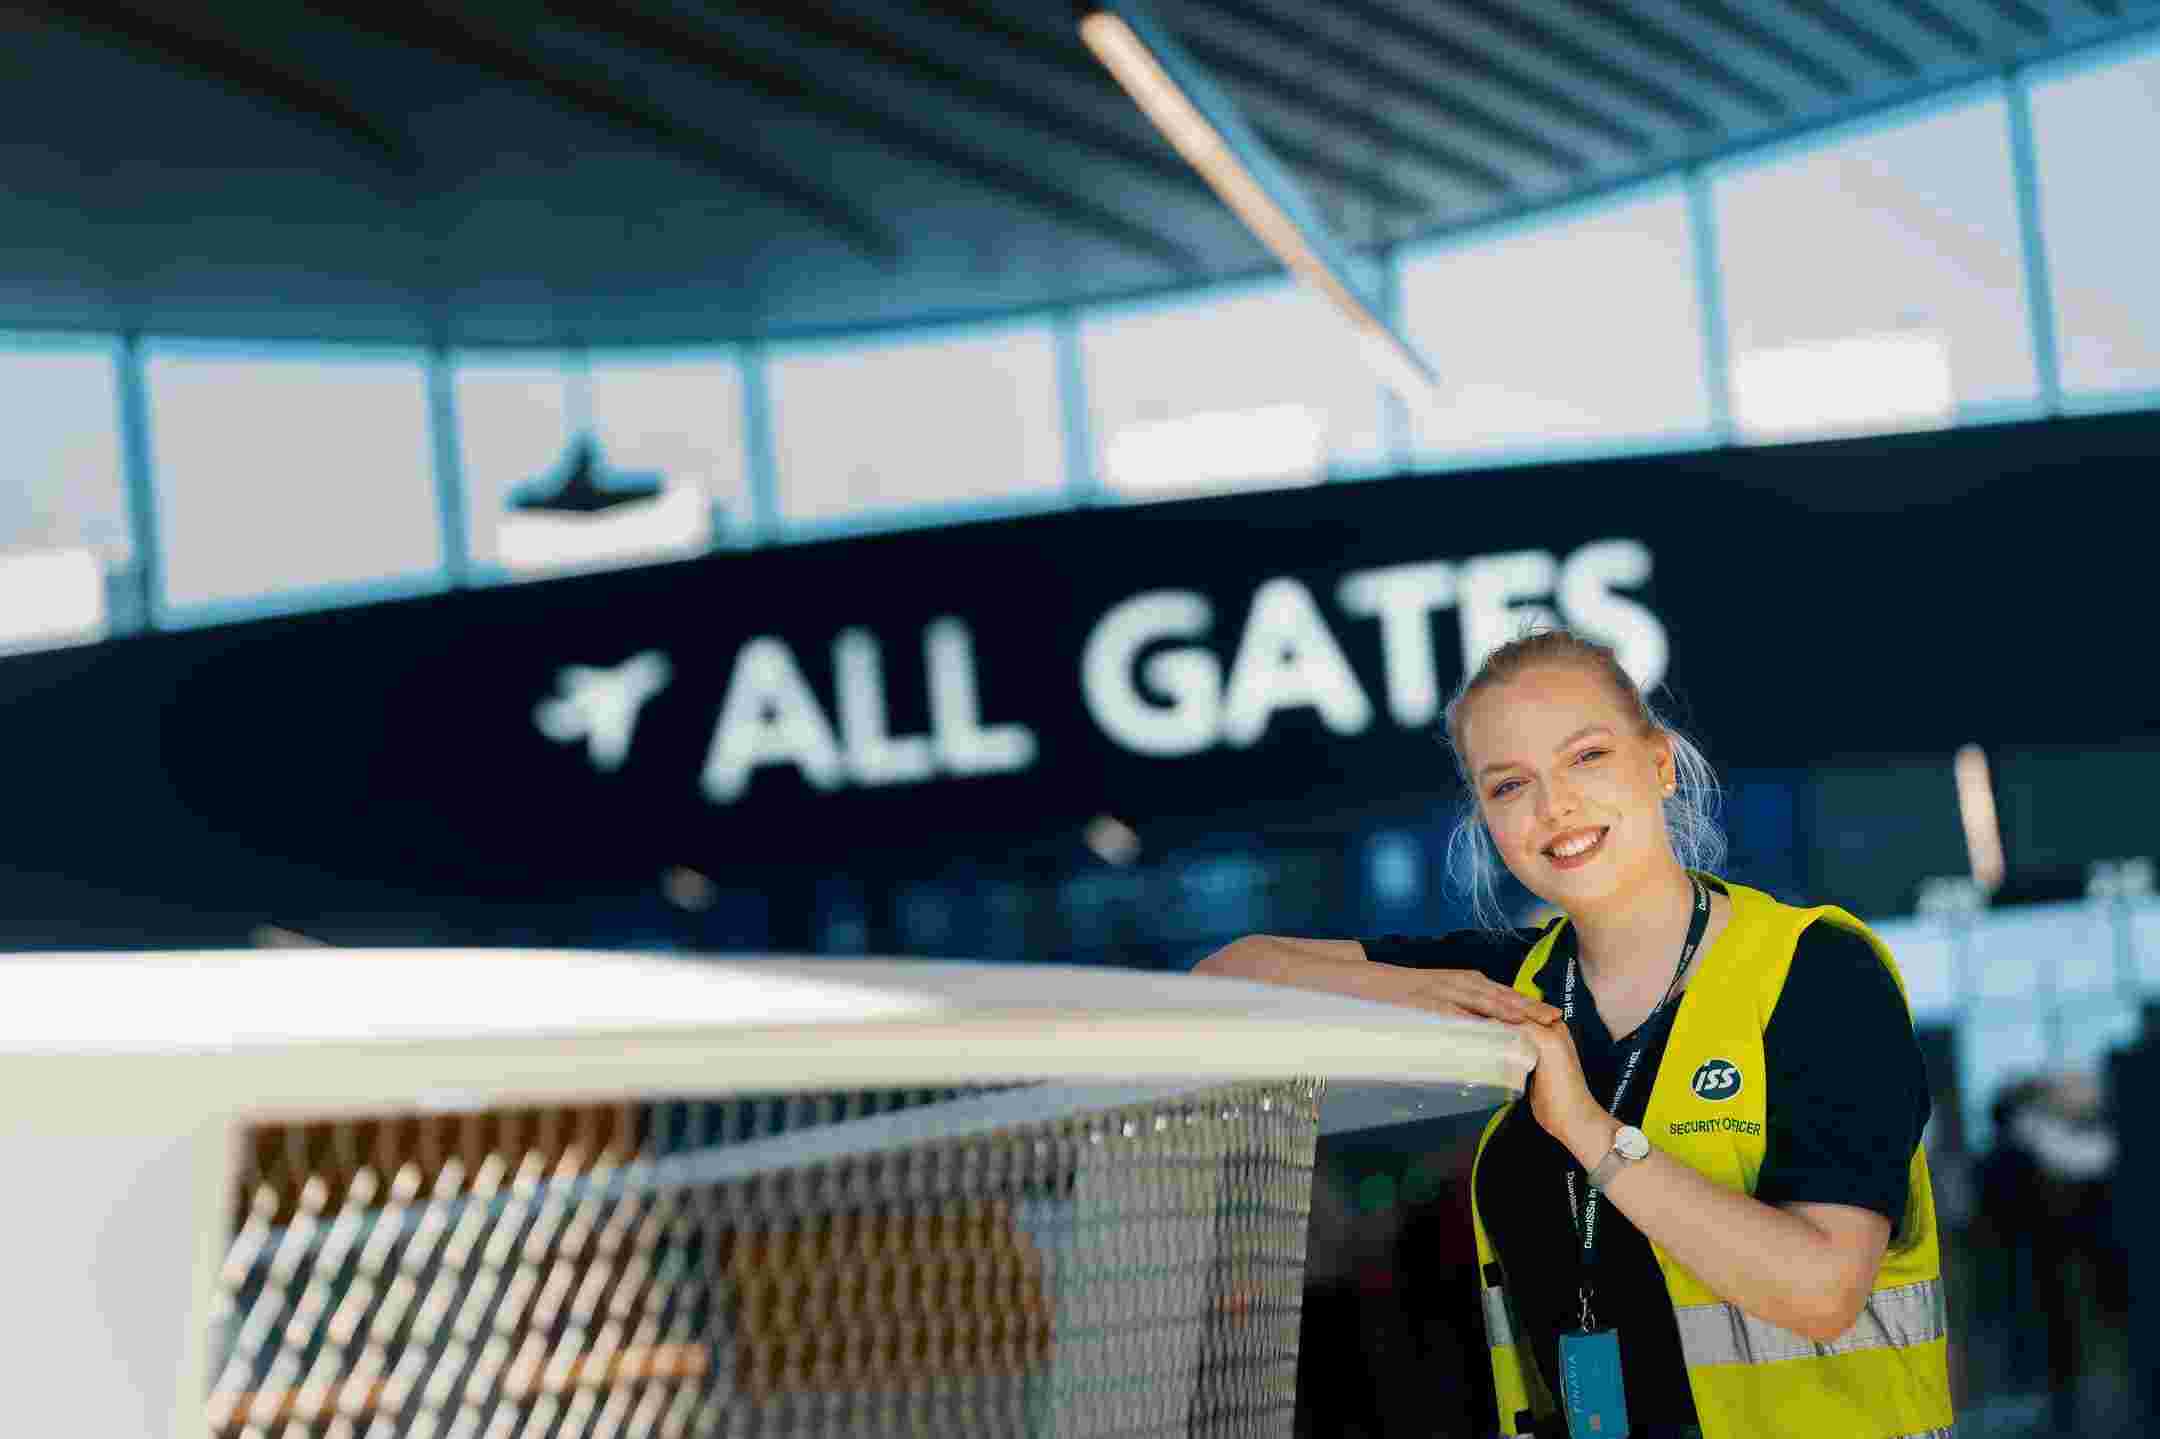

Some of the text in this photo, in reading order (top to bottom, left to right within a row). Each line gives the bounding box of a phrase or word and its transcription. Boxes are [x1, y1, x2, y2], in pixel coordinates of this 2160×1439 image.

[702, 539, 1669, 800] ALL GATES
[1695, 1060, 1736, 1091] ISS
[1669, 1118, 1721, 1136] SECURITY
